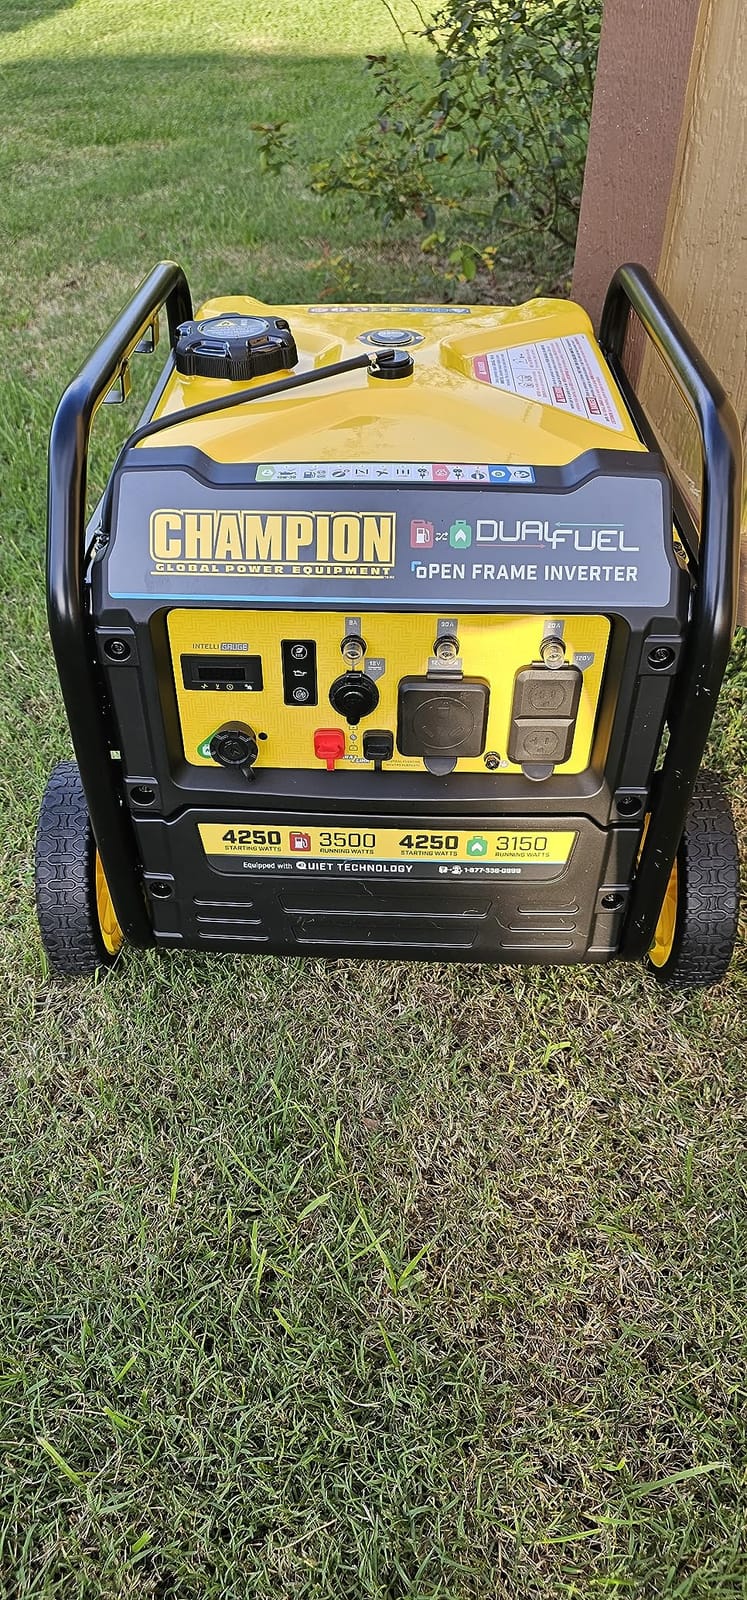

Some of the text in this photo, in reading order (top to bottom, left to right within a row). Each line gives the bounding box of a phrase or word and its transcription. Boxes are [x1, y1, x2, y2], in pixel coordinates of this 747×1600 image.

[152, 511, 393, 564] CHAMPION
[155, 563, 392, 576] GLOBAL POWER EQUIPMENT
[472, 564, 538, 580] FRAME
[544, 565, 638, 582] INVERTER
[575, 654, 592, 662] 120V
[222, 830, 548, 851] 4250 3500 4250 3150
[242, 861, 414, 873] Equipped with QUIET TECHNOLOGY
